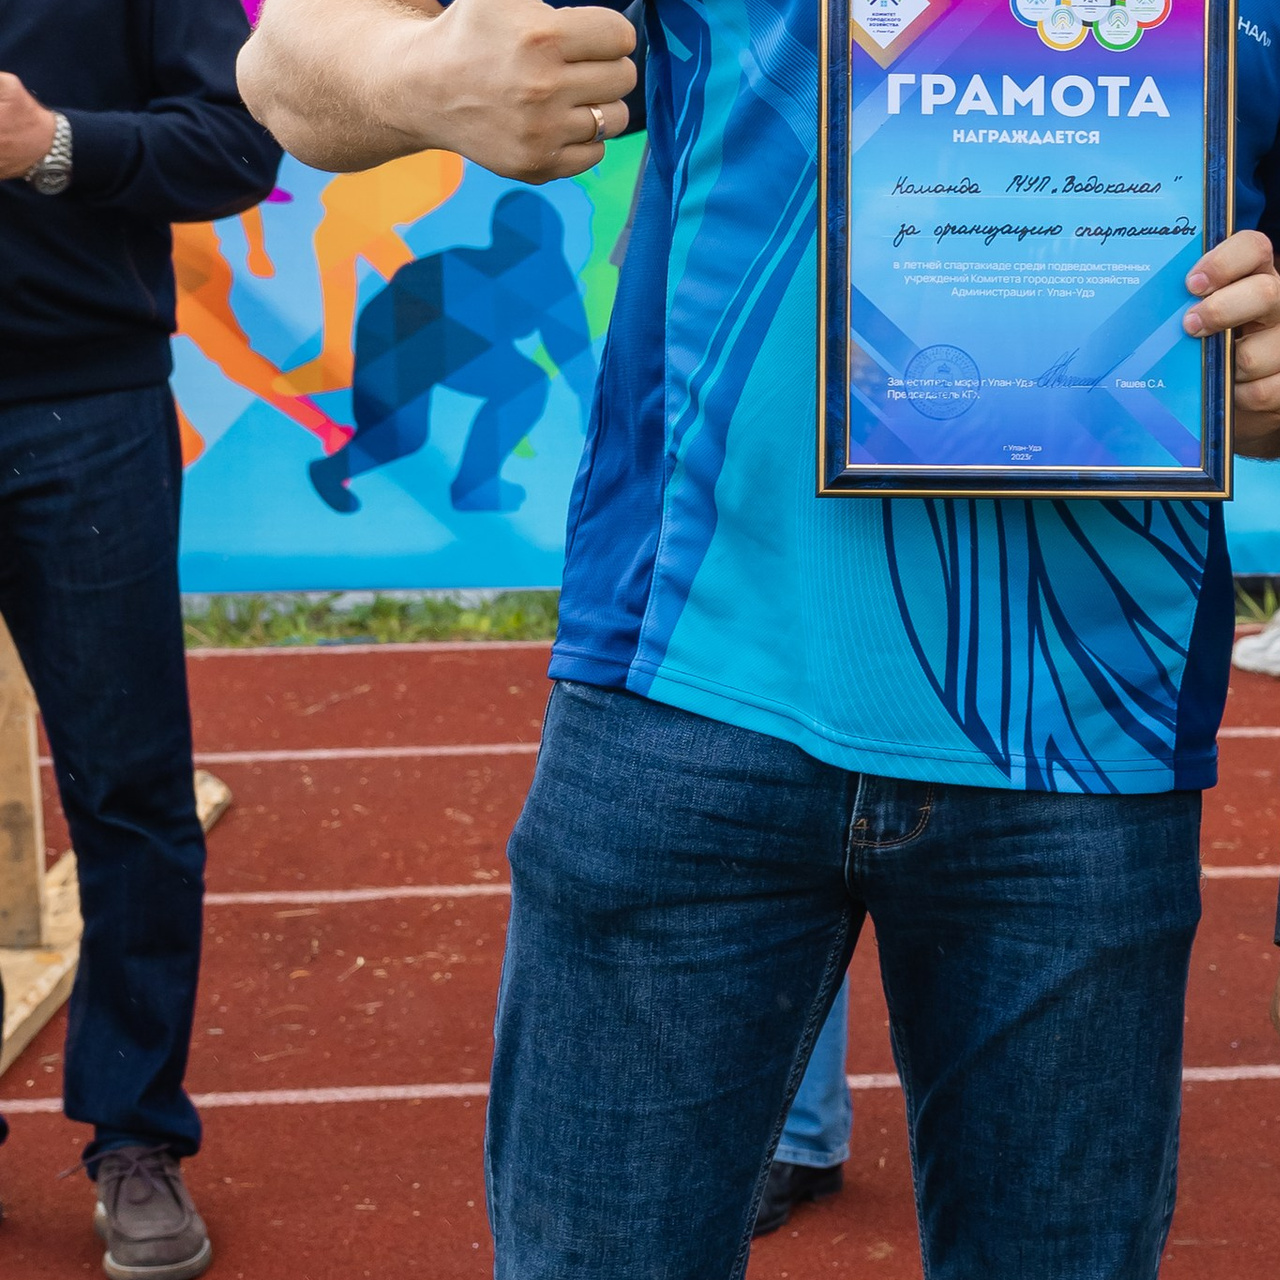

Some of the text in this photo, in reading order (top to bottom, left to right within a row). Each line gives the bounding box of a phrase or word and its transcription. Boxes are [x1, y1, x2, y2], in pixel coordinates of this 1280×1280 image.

[887, 73, 1171, 118] ГРАМОТА
[952, 129, 1101, 145] НАГРАЖДАЕТСЯ
[891, 176, 982, 196] Команда
[893, 216, 1197, 248] за организацию спартакиады
[893, 259, 1151, 273] в летней спартакиаде среди подведомственных
[904, 273, 1140, 286] учреждений Комитета городского хозяйства
[951, 286, 1036, 299] Администрации
[1047, 287, 1095, 299] Улан-Удэ
[1115, 378, 1147, 389] Гашев
